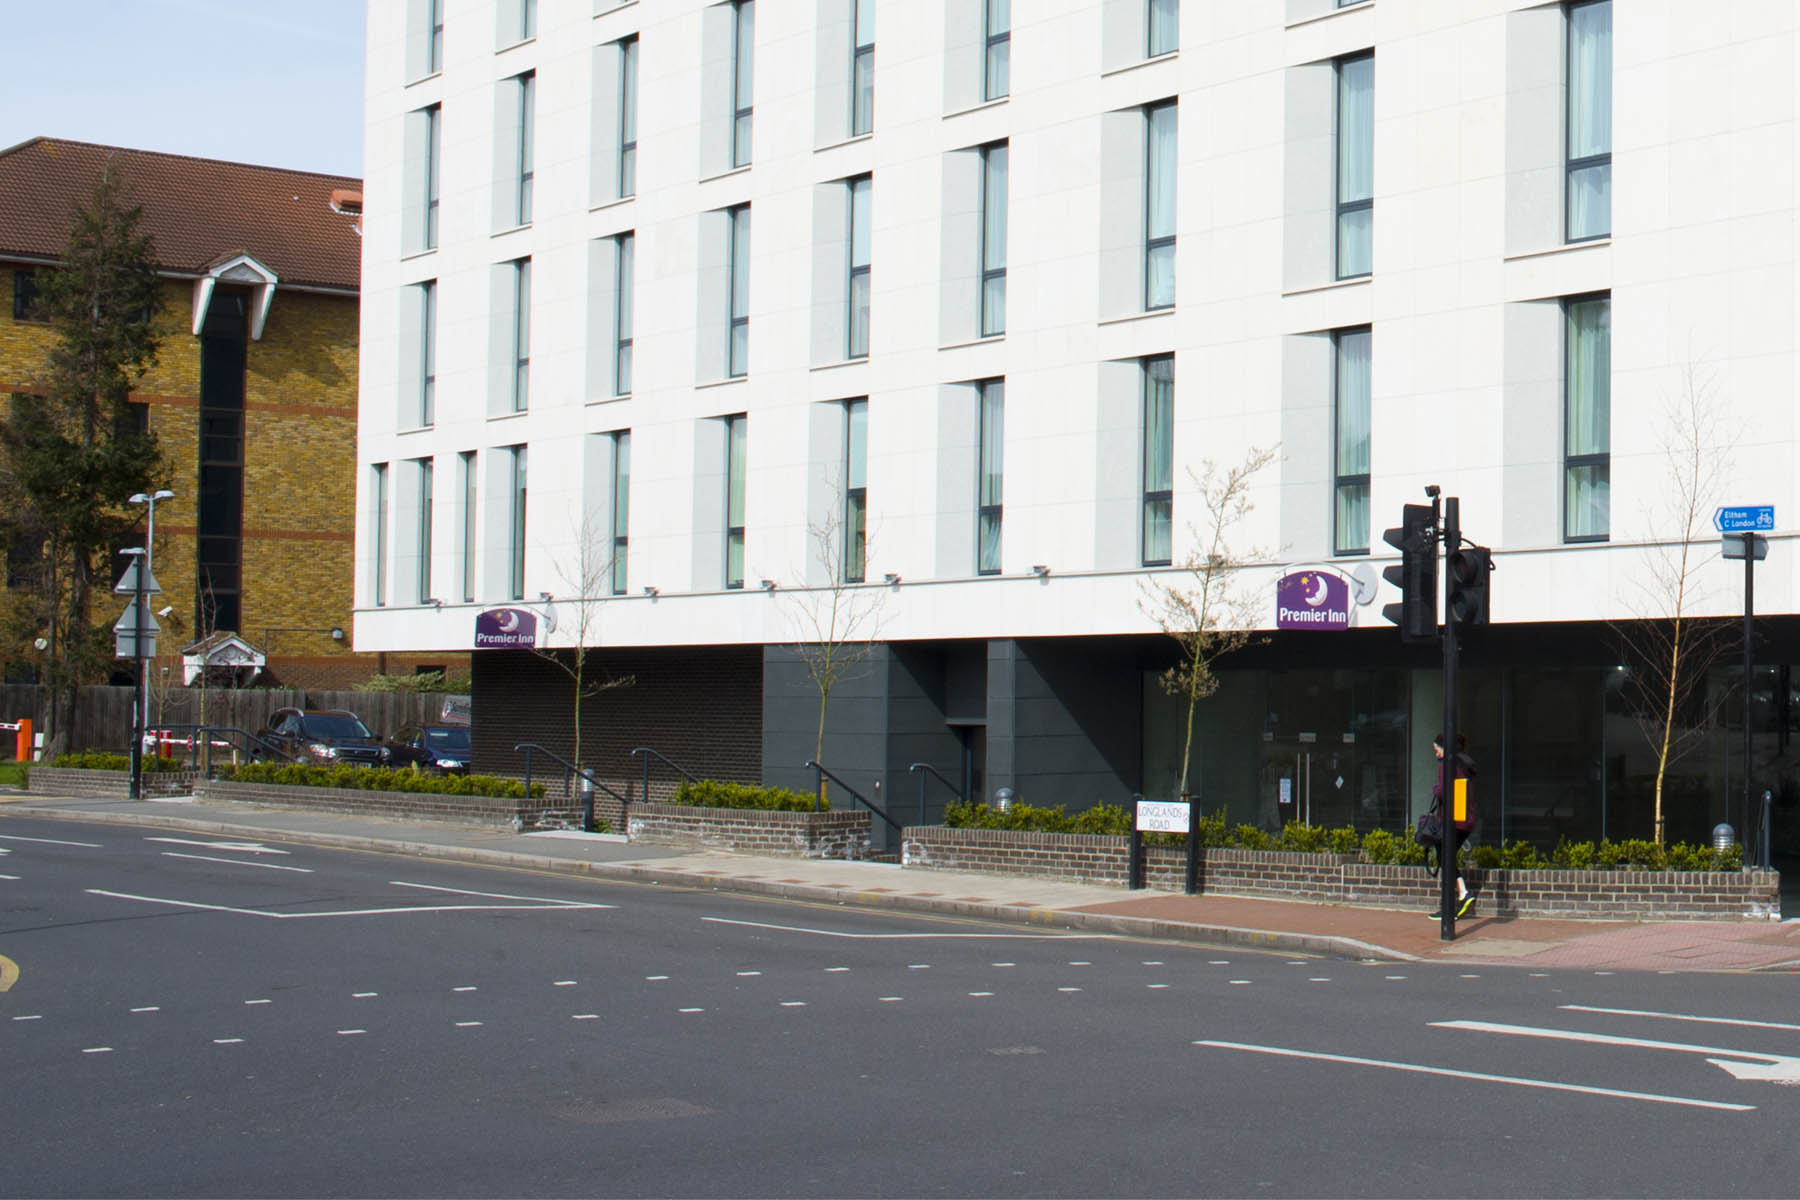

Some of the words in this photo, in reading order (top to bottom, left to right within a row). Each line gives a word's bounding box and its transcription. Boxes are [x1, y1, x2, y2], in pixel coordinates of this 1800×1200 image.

[1731, 519, 1756, 528] London
[1280, 607, 1327, 623] Premier
[1328, 608, 1347, 623] Inn
[477, 632, 517, 644] Premier
[518, 633, 535, 644] Inn
[1138, 805, 1183, 818] LONGLANDS
[1149, 818, 1170, 830] ROAD
